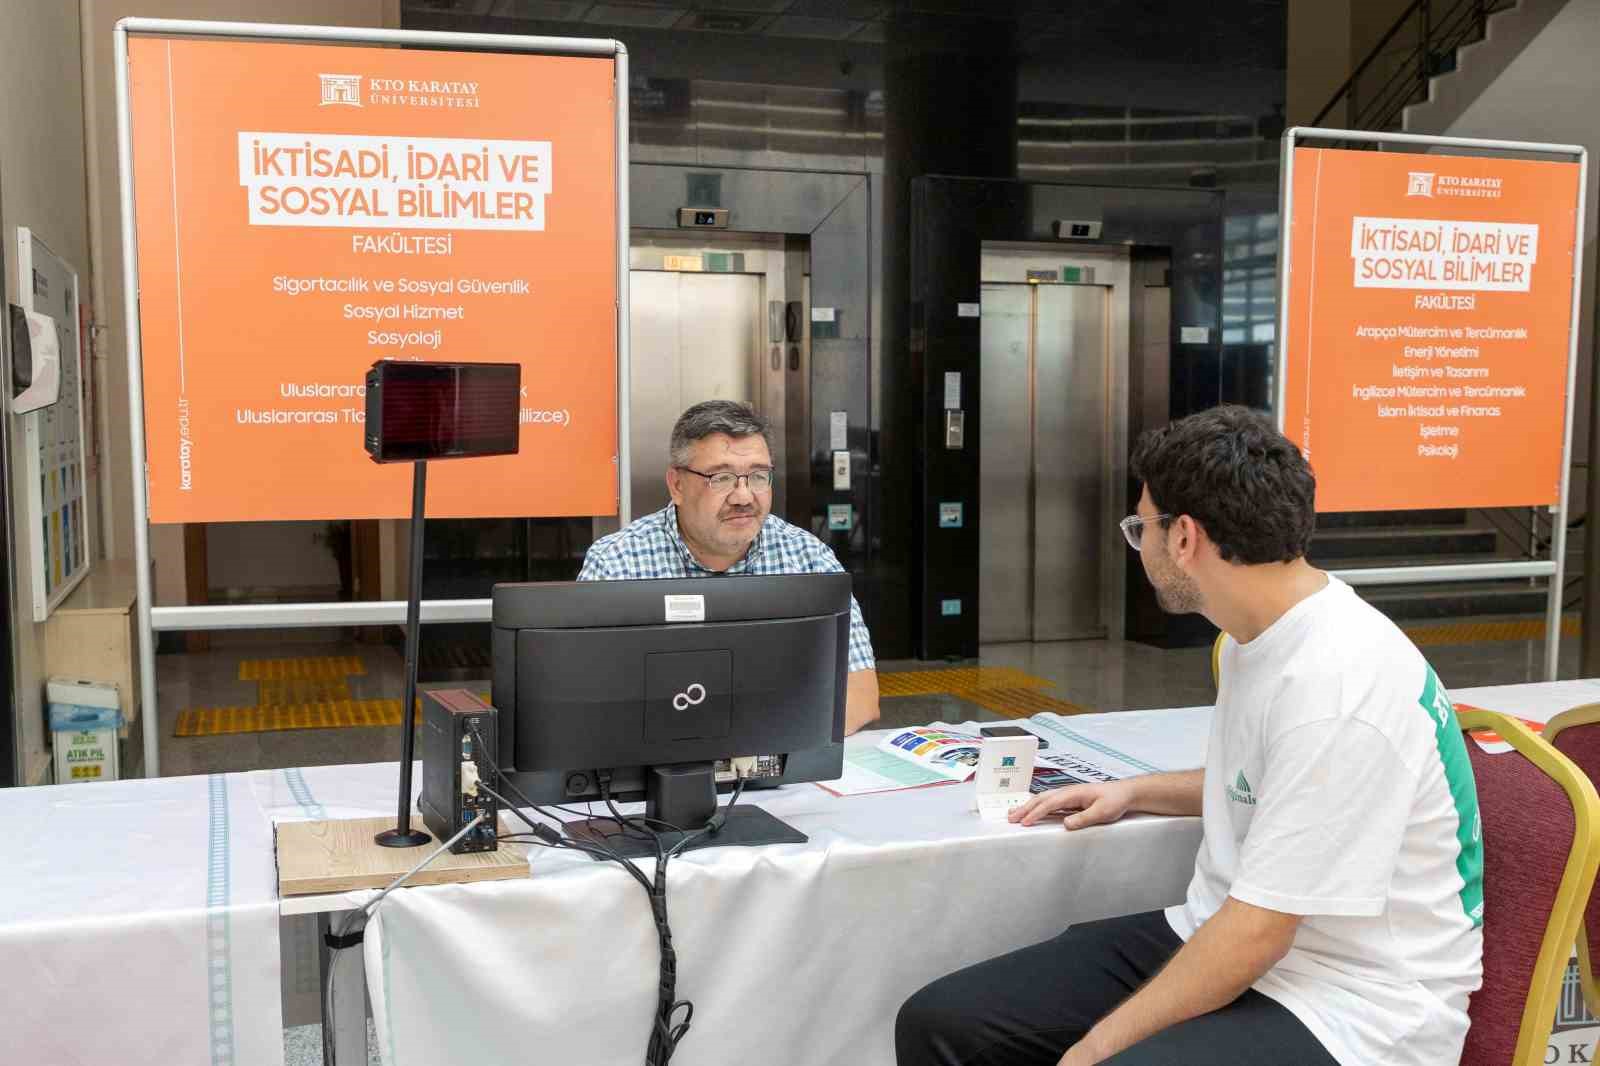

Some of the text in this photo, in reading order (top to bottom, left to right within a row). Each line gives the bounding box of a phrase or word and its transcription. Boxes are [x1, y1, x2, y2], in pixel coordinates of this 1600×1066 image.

[370, 79, 479, 95] KTO KARATAY
[253, 139, 540, 183] İKTİSADİ, İDARİ VE
[259, 183, 534, 220] SOSYAL BİLİMLER
[352, 232, 453, 255] FAKÜLTESİ
[1360, 223, 1530, 256] İKTİSADİ, İDARİ VE
[1361, 256, 1524, 283] SOSYAL BİLİMLER
[272, 276, 530, 296] Sigortacılık ve Sosyal Güvenlik
[1414, 293, 1475, 310] FAKÜLTESİ
[343, 304, 465, 322] Sosyal Hizmet
[367, 330, 442, 350] Sosyoloji
[1356, 325, 1397, 340] Arapça
[1398, 325, 1448, 338] Mütercim
[1449, 328, 1463, 338] ve
[1404, 346, 1480, 360] Enerji Yönetimi
[1430, 368, 1444, 378] ve
[280, 382, 367, 398] Uluslarara
[1449, 388, 1462, 398] ve
[236, 408, 338, 424] Uluslararası
[1447, 407, 1459, 416] ve
[178, 396, 194, 490] karatay.edu.tr
[1417, 443, 1458, 459] Psikoloji
